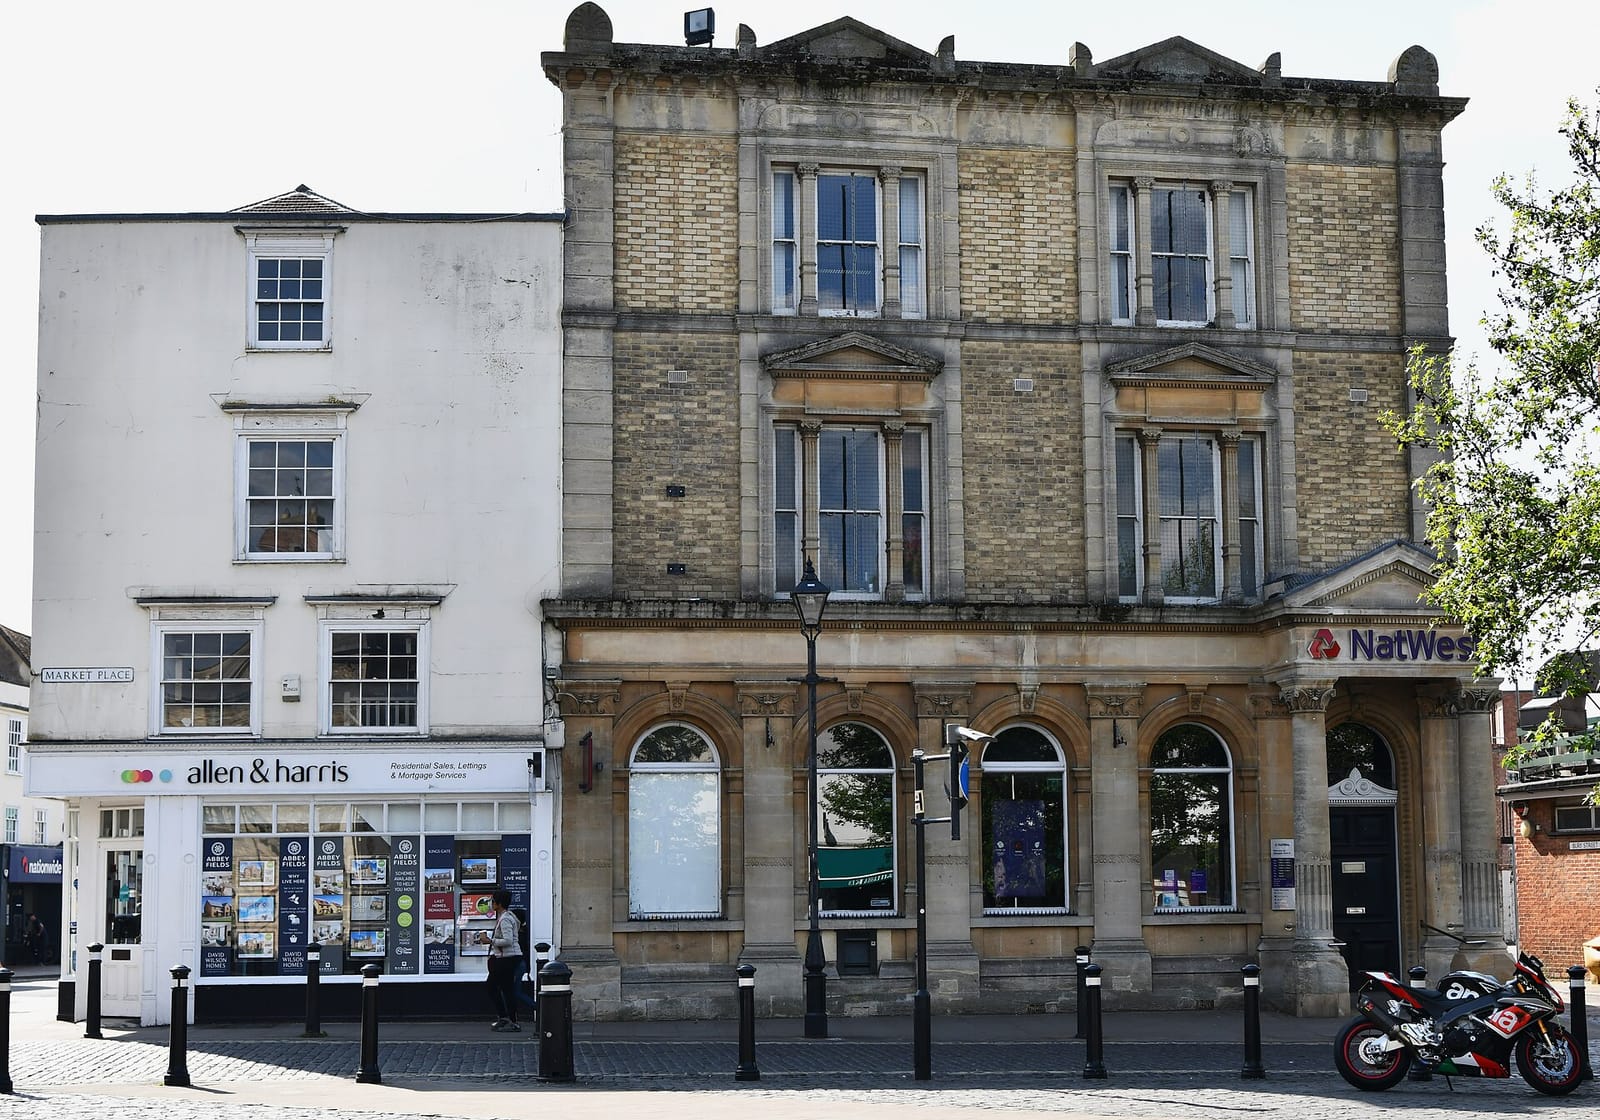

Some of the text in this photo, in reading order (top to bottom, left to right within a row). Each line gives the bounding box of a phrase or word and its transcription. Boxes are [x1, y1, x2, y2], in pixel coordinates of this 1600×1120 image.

[45, 670, 131, 680] MARKET PLACE
[187, 758, 349, 783] allen & harris
[390, 762, 487, 772] Residential Sales, Lettings
[398, 772, 433, 781] Mortgage
[435, 771, 467, 779] Services
[29, 858, 62, 874] nationwide
